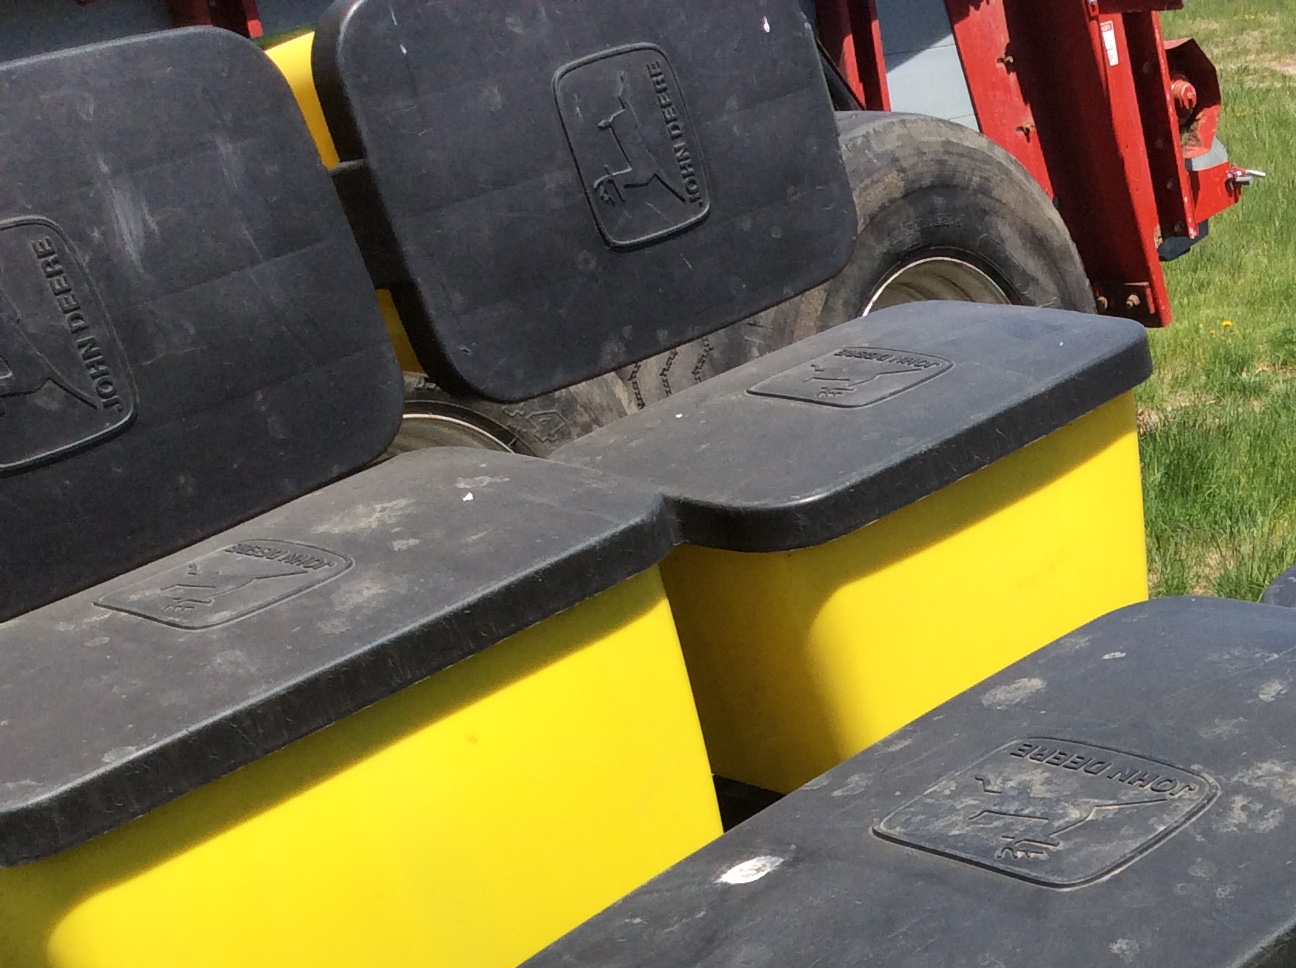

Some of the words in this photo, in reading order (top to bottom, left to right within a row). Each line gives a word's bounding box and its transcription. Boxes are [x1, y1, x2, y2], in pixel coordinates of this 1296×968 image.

[646, 60, 684, 141] DEERE
[673, 142, 704, 208] JOHN
[31, 235, 89, 334] DEERE
[76, 335, 124, 413] JOHN
[1010, 743, 1111, 775] DEERE
[1106, 767, 1198, 797] JOHN
